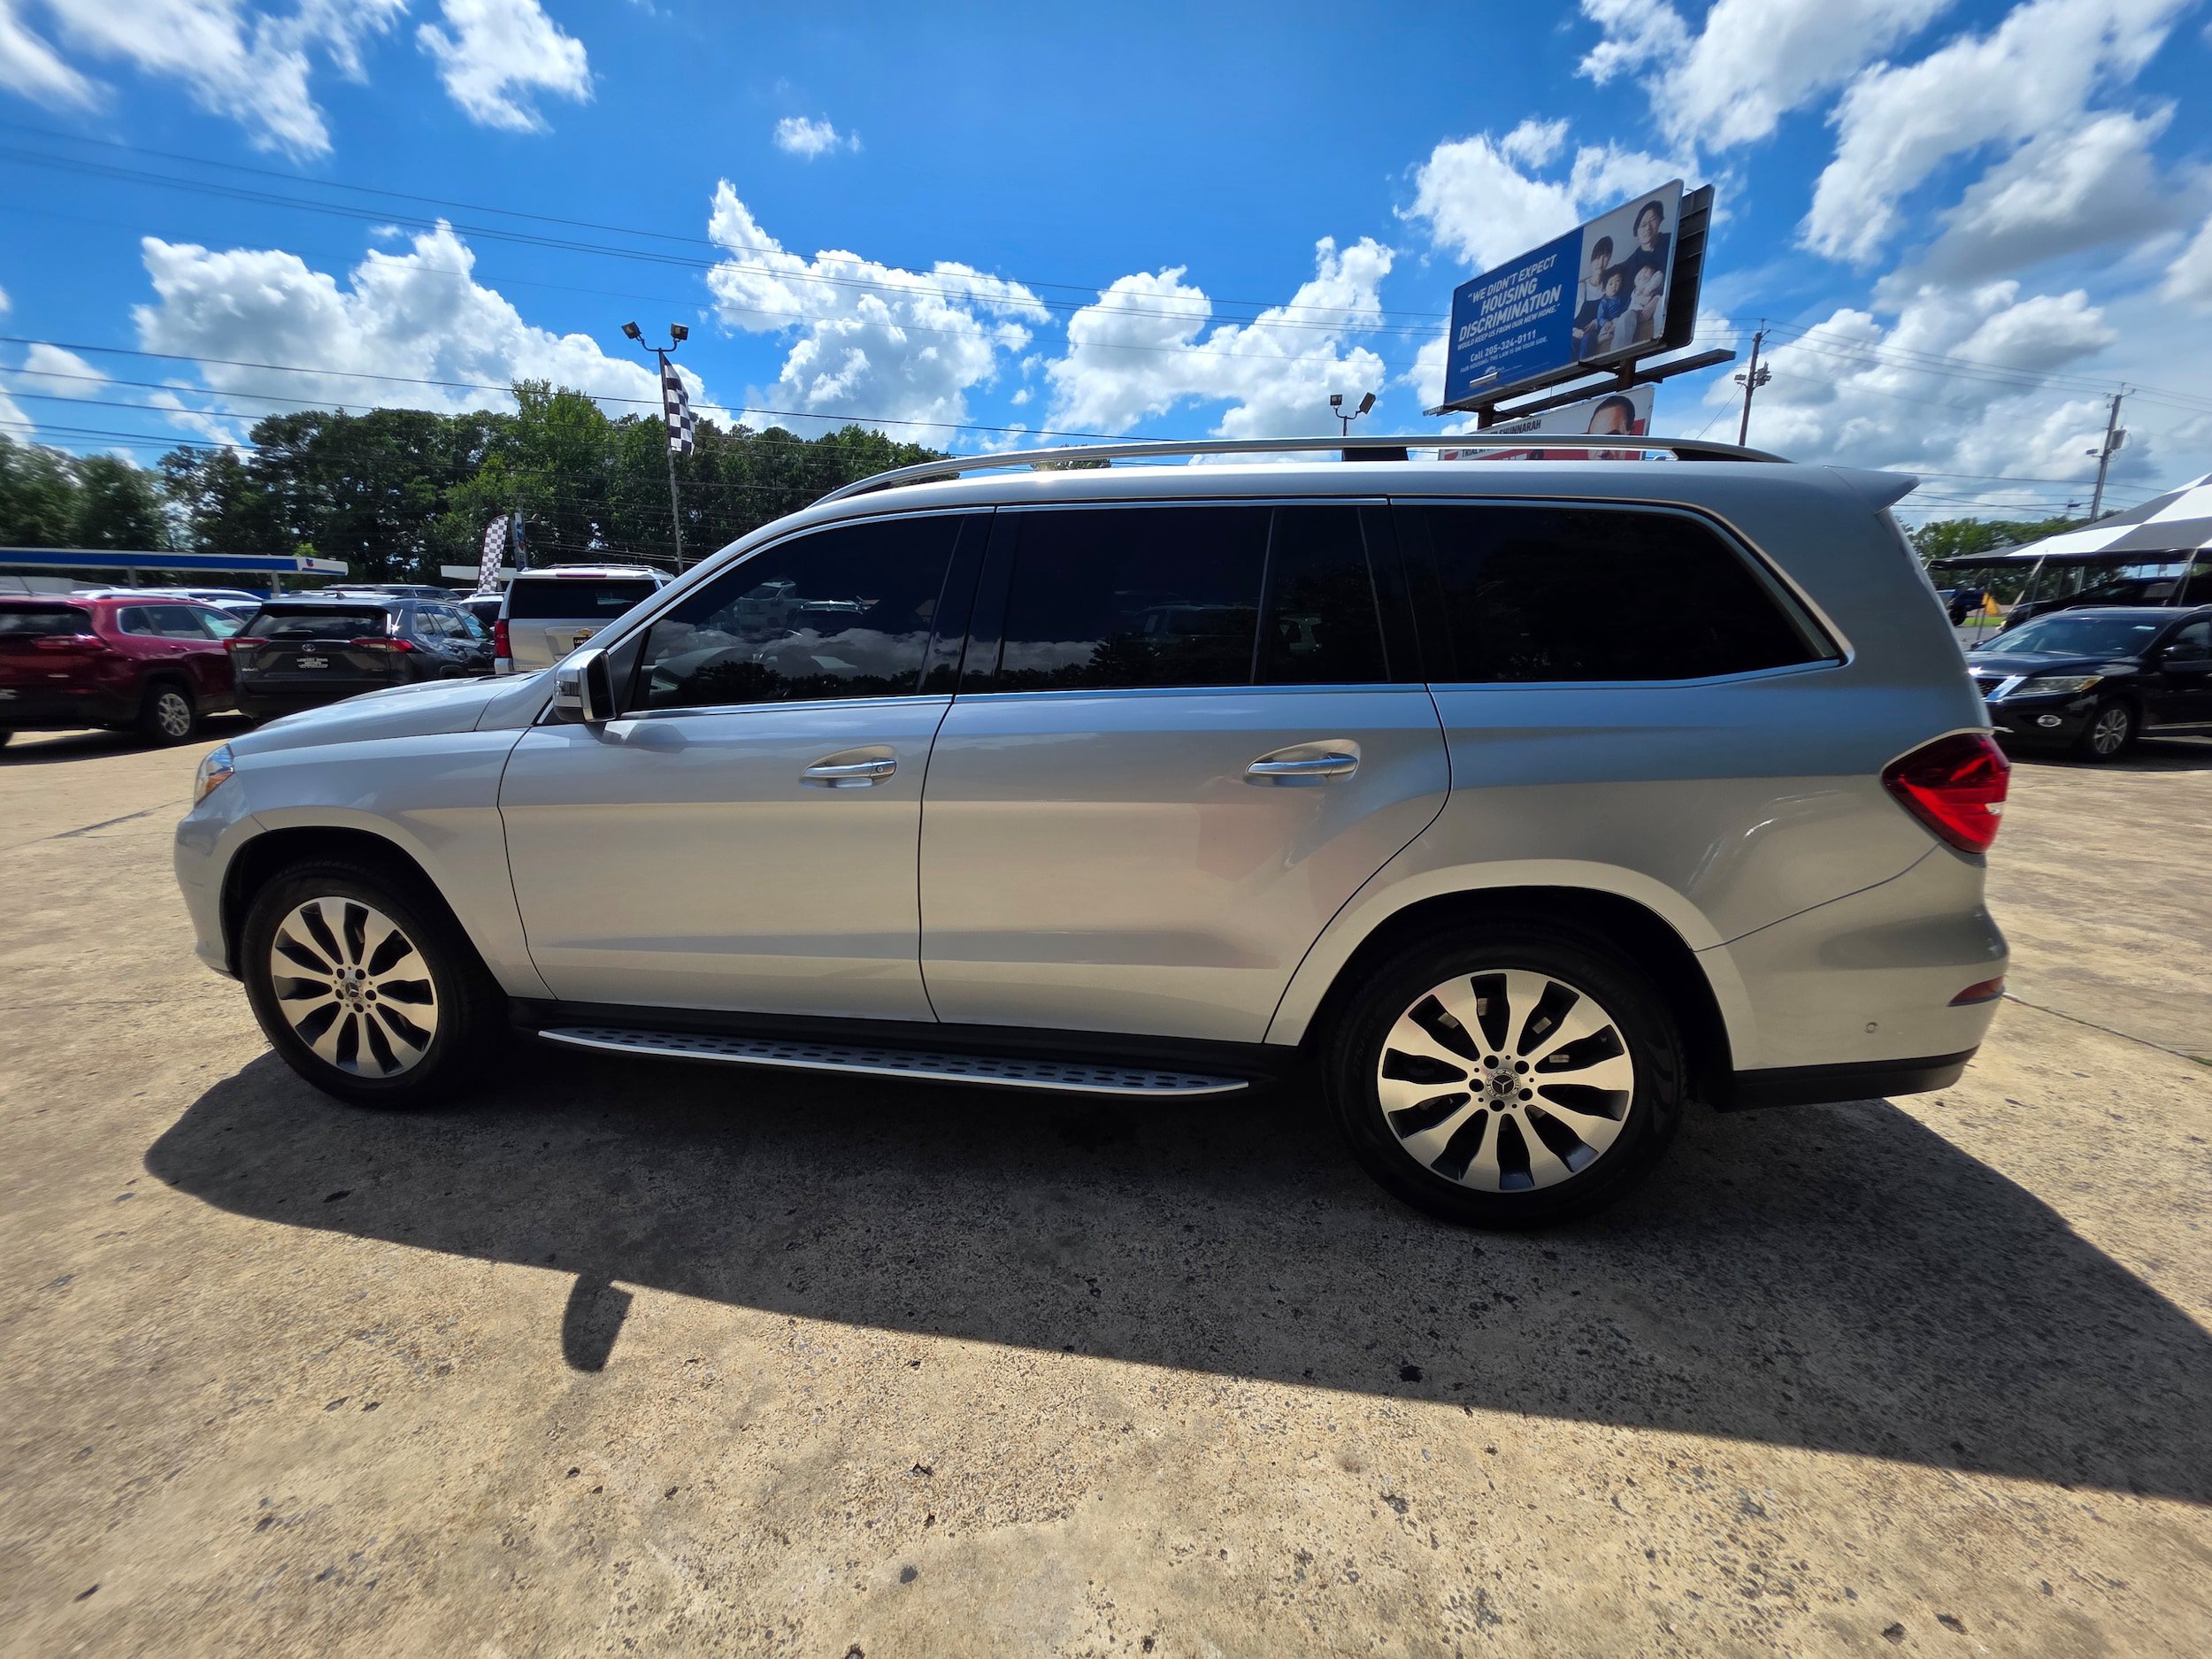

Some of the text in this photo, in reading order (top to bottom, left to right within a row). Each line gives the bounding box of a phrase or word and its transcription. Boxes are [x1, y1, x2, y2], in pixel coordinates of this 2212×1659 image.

[1486, 273, 1518, 296] DIDN'T
[1518, 254, 1557, 281] EXPECT
[1458, 284, 1562, 342] DISCRIMINATION
[1480, 277, 1538, 316] HOUSING
[1457, 339, 1474, 351] WOULD
[1474, 333, 1488, 344] KEEP
[1488, 330, 1496, 339] US
[1495, 323, 1511, 335] FROM
[1511, 318, 1524, 329] OUR
[1523, 311, 1539, 324] NEW
[1470, 329, 1537, 362] Call 205-324-0111
[1499, 349, 1509, 359] LAW
[1522, 340, 1535, 349] YOUR
